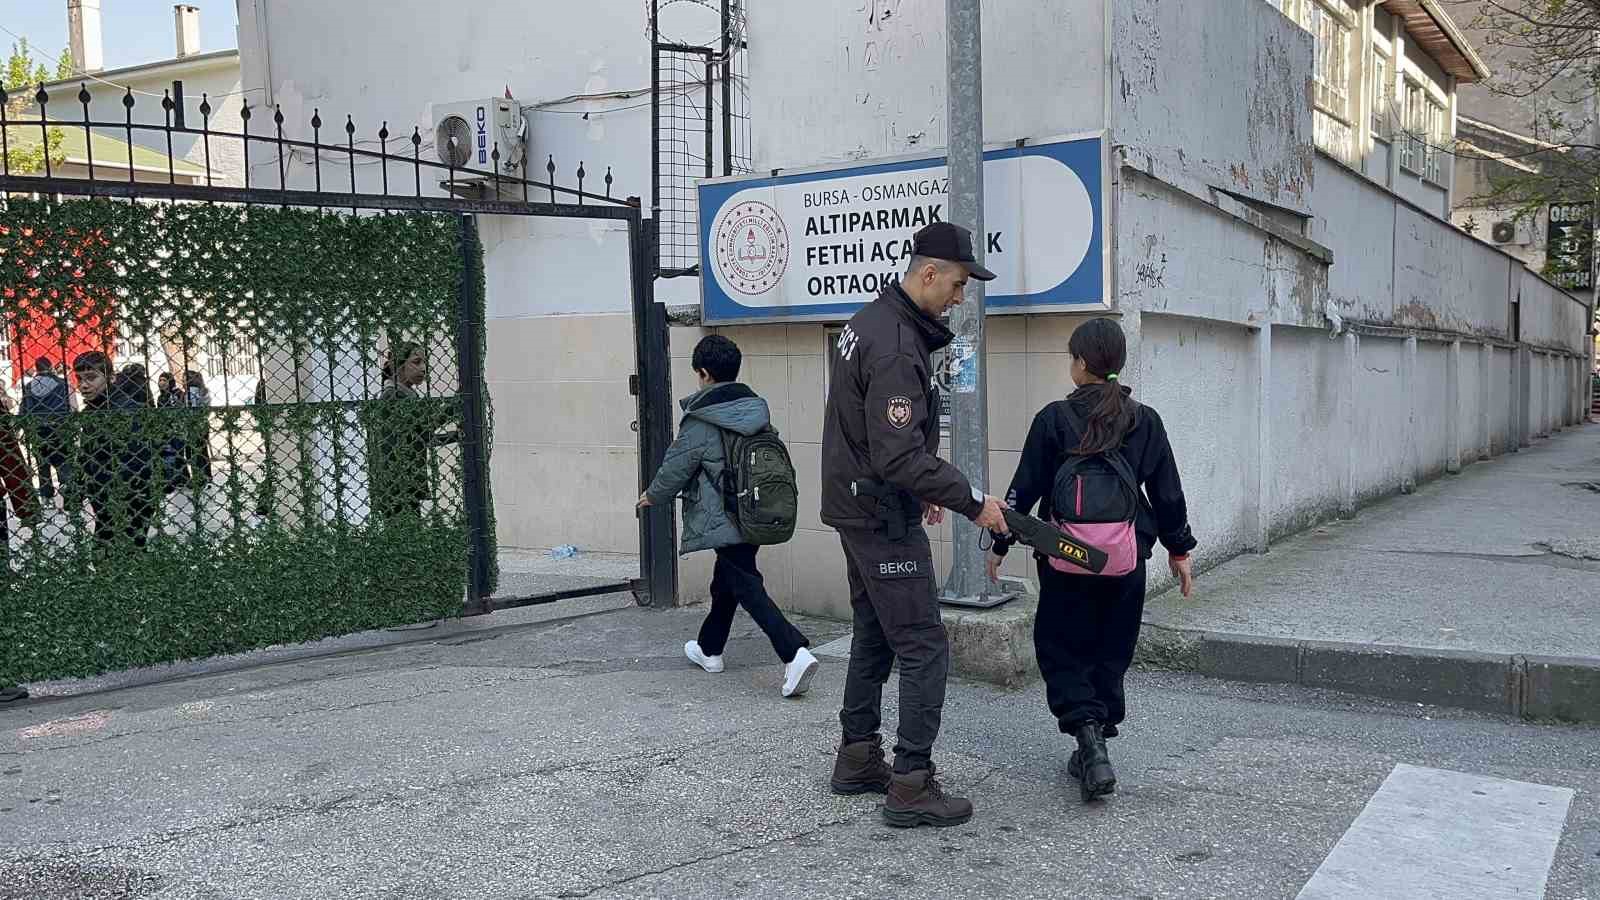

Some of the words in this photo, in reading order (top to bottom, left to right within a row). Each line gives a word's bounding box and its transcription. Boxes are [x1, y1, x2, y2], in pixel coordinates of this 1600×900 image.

[476, 106, 487, 164] BEKO
[804, 189, 850, 208] BURSA
[861, 178, 949, 202] OSMANGAZ
[804, 203, 942, 237] ALTIPARMAK
[806, 238, 864, 266] FETHİ
[870, 239, 913, 267] AÇA
[807, 272, 899, 296] ORTAOK
